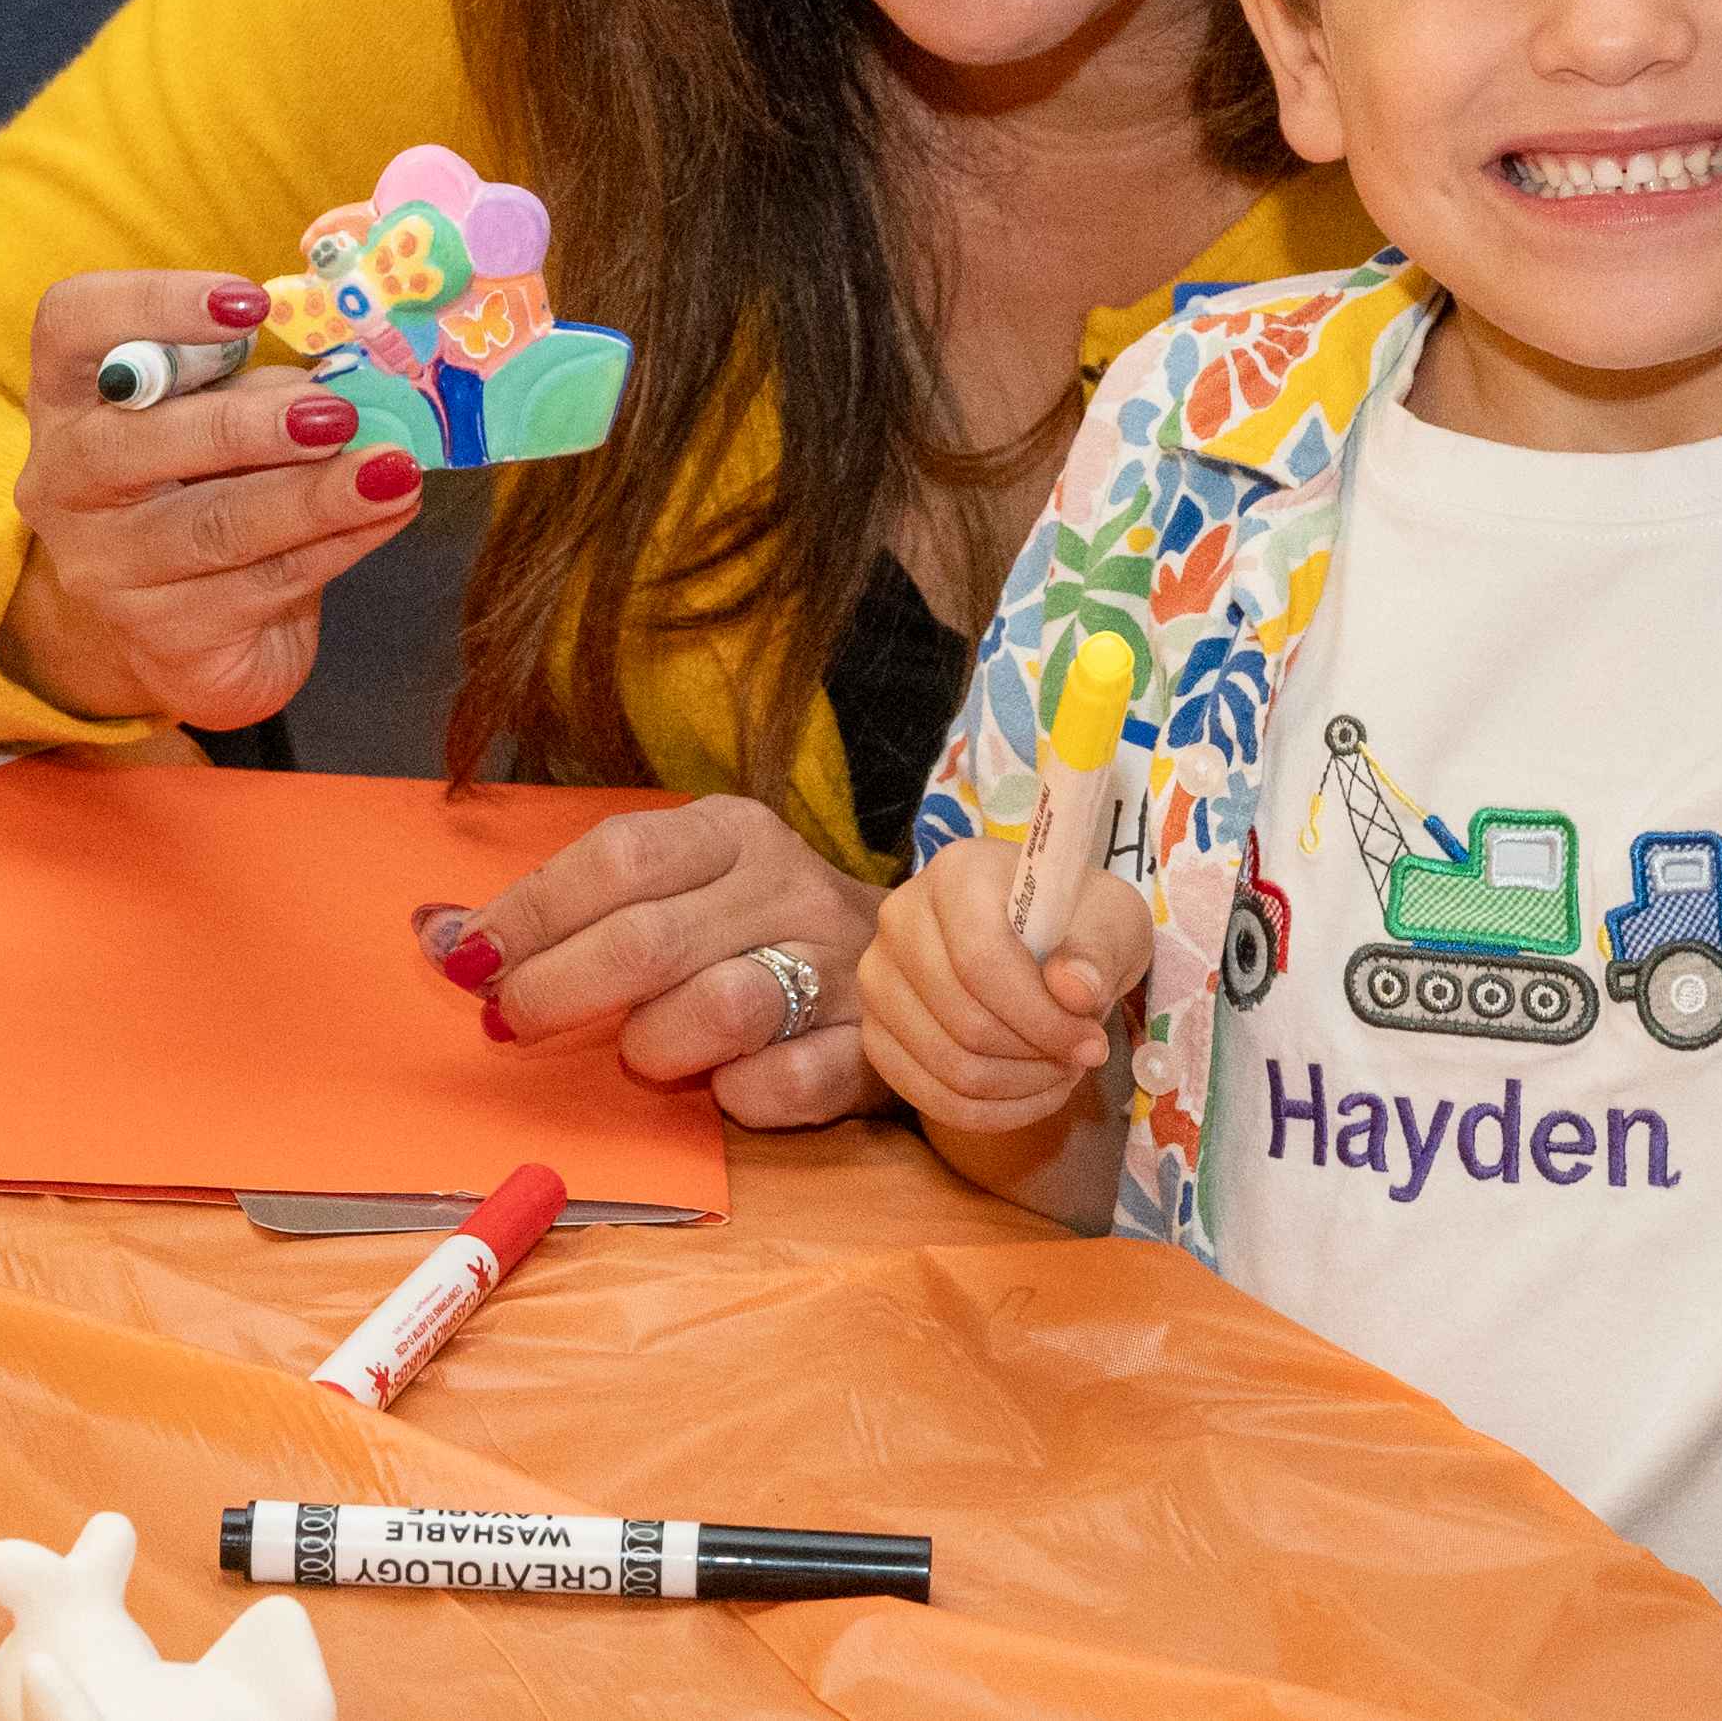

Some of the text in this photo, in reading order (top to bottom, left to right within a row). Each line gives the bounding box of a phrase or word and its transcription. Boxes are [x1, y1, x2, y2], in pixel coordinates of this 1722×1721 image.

[1265, 1058, 1683, 1204] Hayden
[386, 1520, 572, 1548] WASHABLE
[355, 1557, 613, 1591] CREATOLOGY
